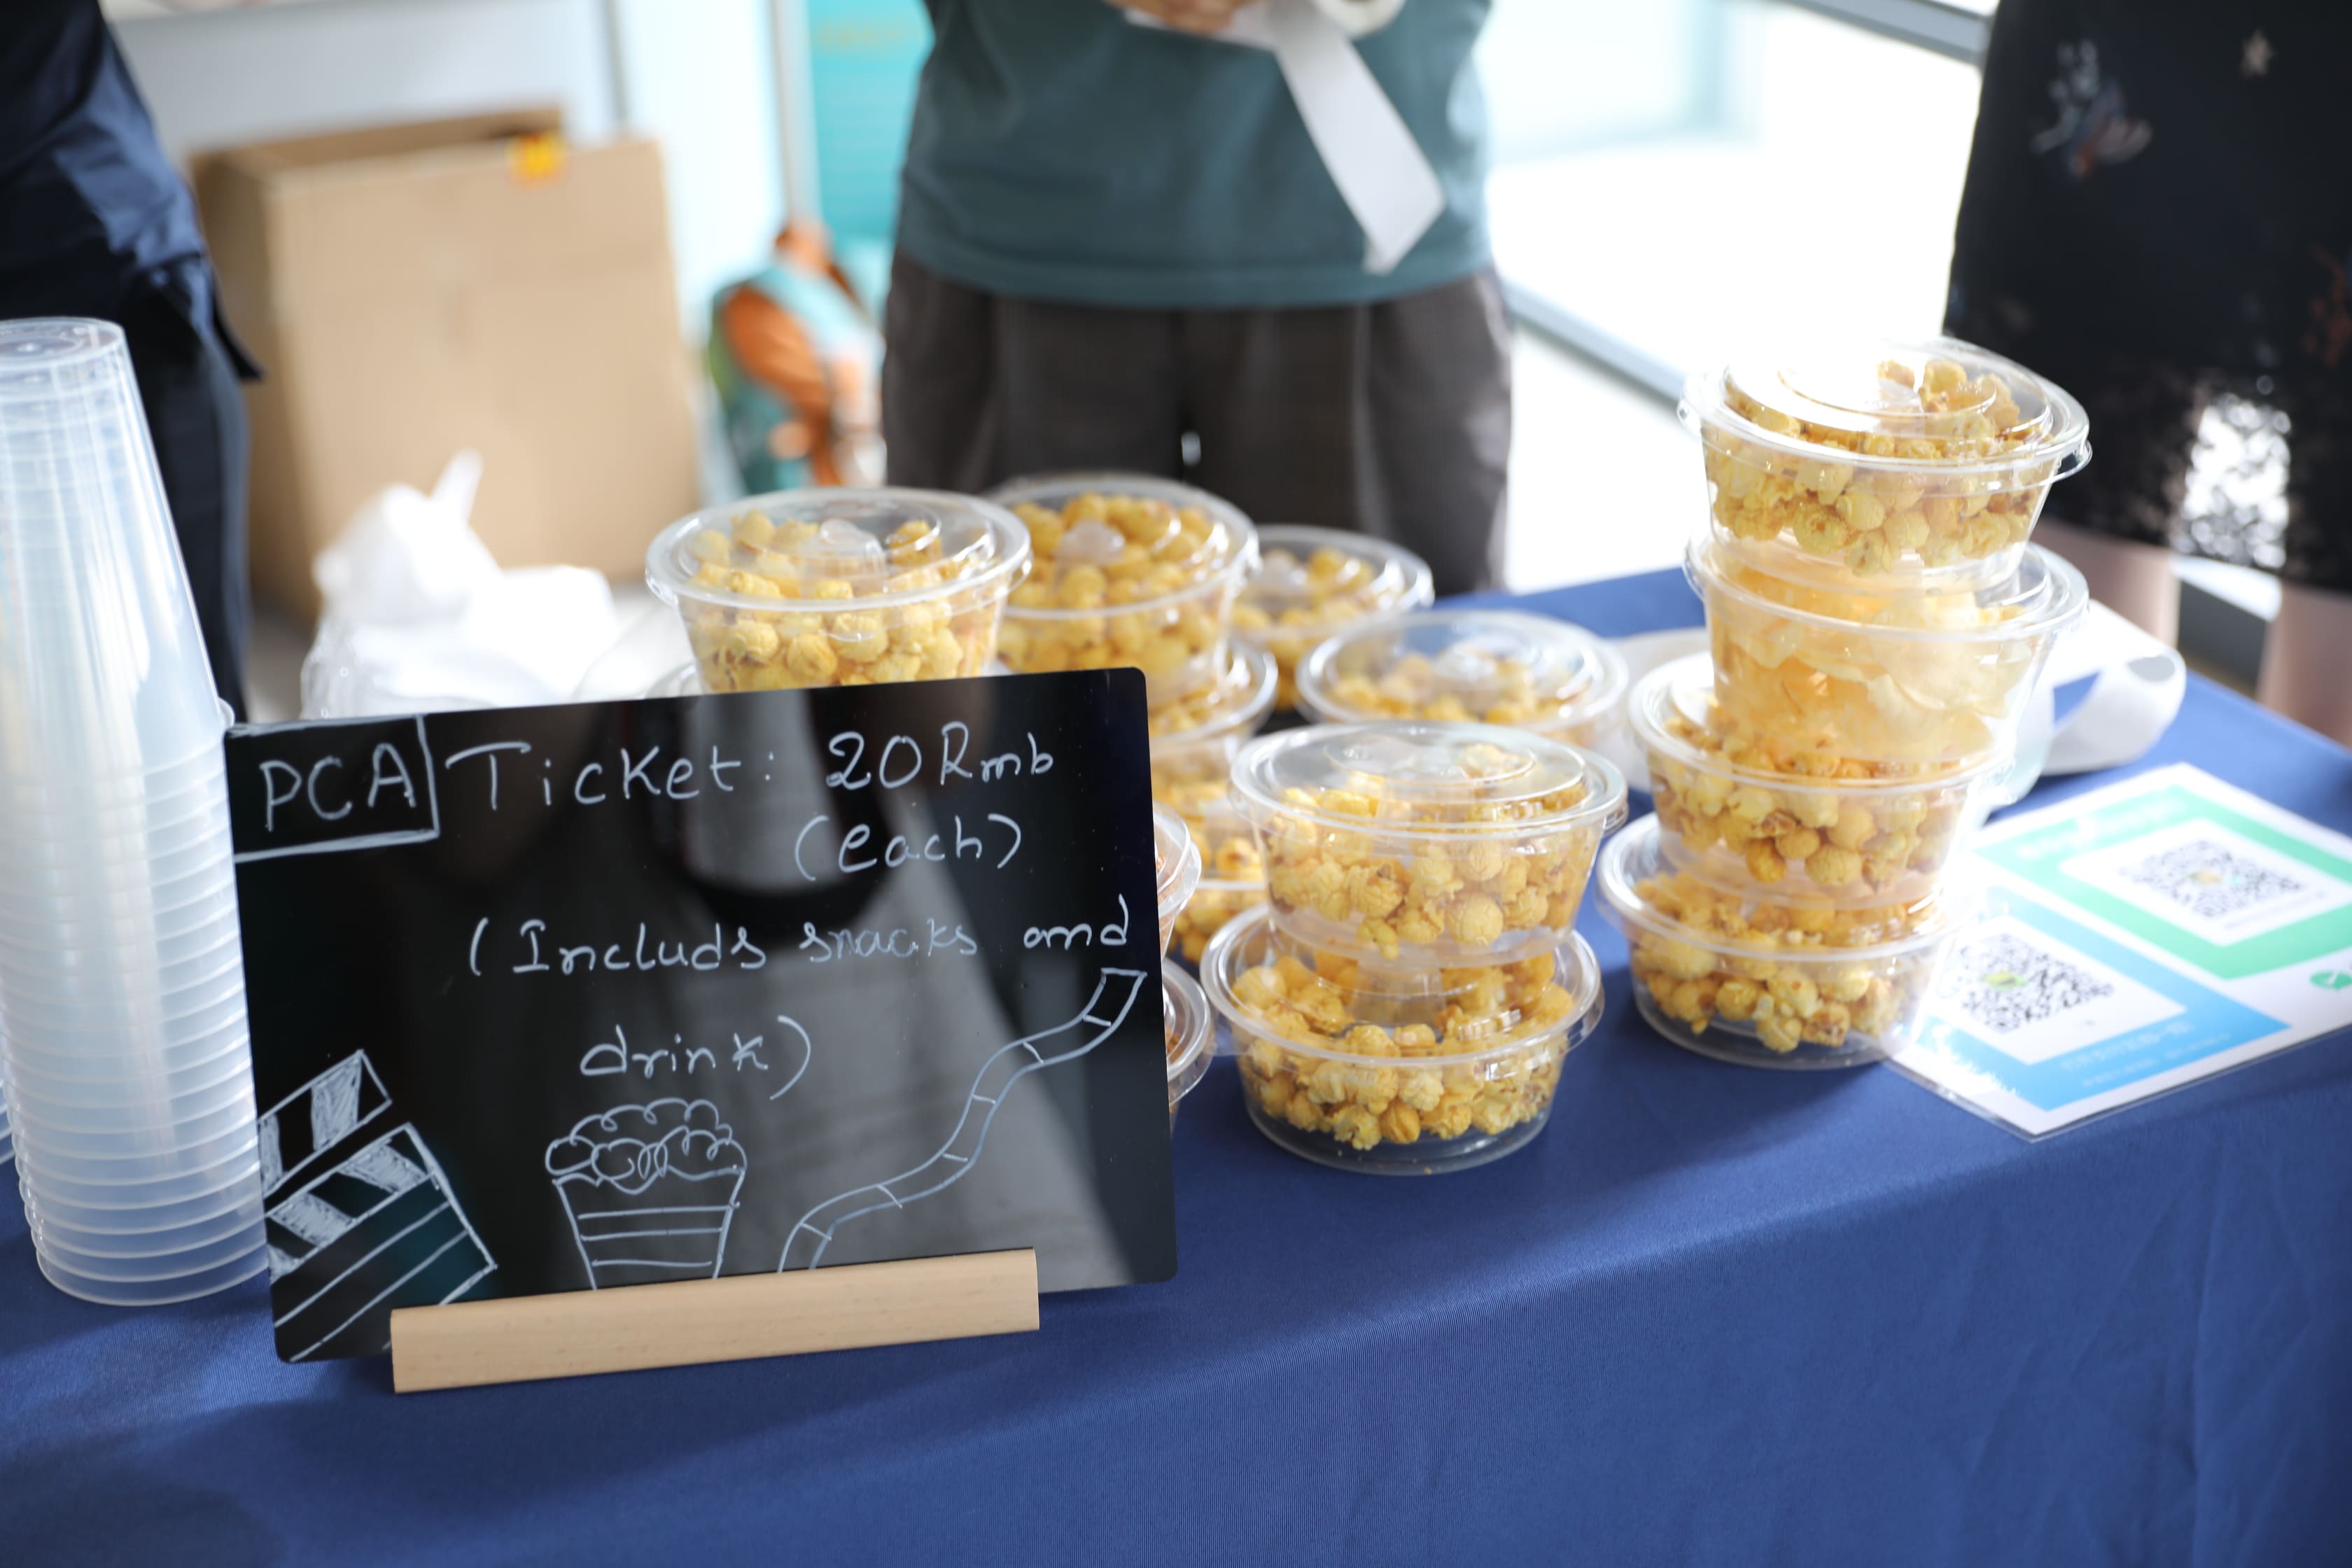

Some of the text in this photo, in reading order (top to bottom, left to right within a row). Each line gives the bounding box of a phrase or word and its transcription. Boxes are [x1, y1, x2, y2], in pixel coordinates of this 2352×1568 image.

[260, 742, 417, 832] PCA
[794, 813, 1021, 881] (each)
[799, 918, 977, 962] snacks
[1023, 893, 1128, 949] and
[580, 1014, 811, 1100] drink)
